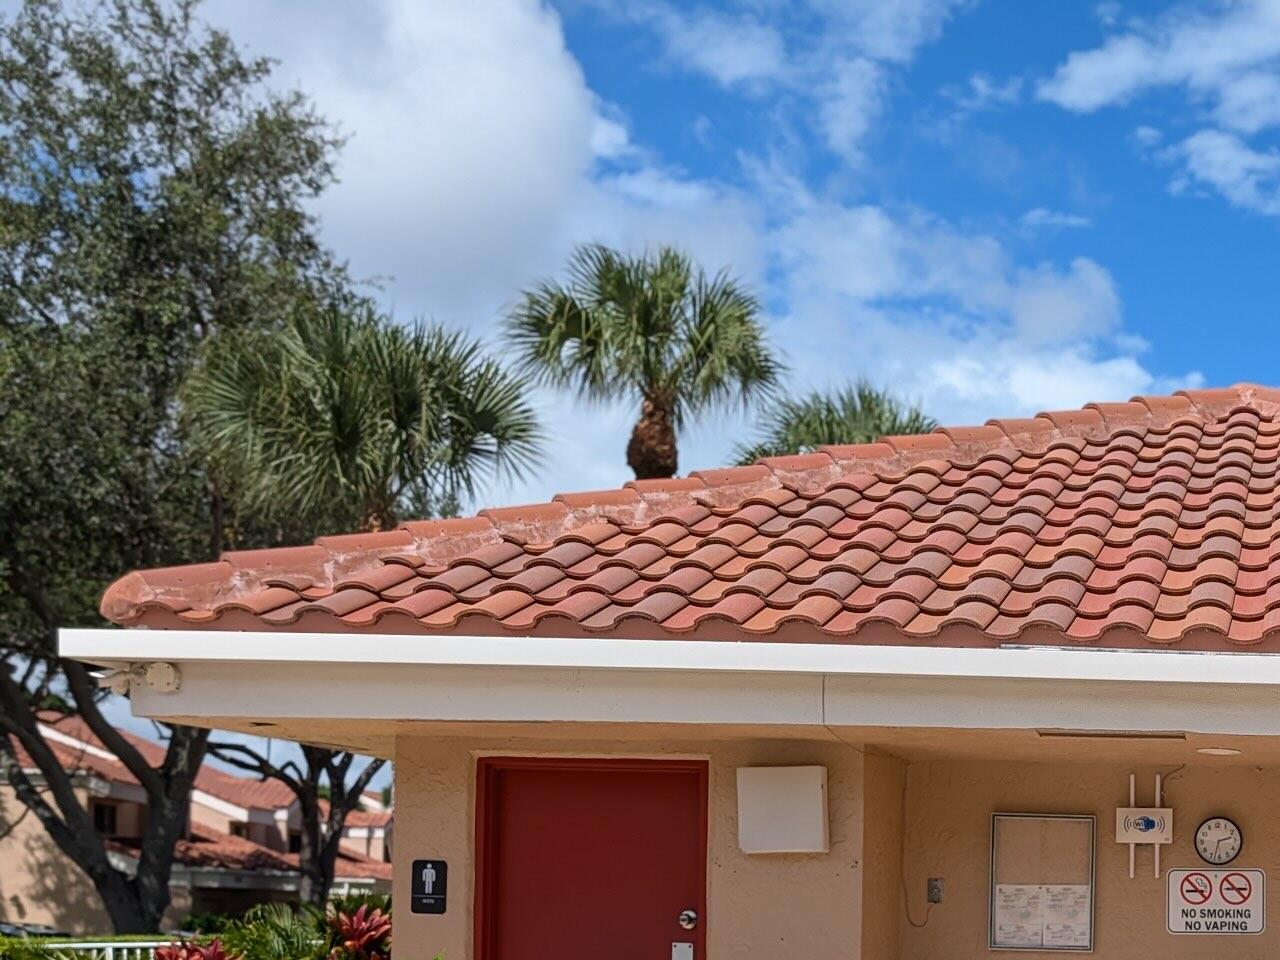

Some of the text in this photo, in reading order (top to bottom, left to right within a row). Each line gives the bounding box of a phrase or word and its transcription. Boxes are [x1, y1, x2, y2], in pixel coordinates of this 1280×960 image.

[1181, 909, 1251, 918] NO SMOKING
[1185, 921, 1248, 930] NO VAPING
